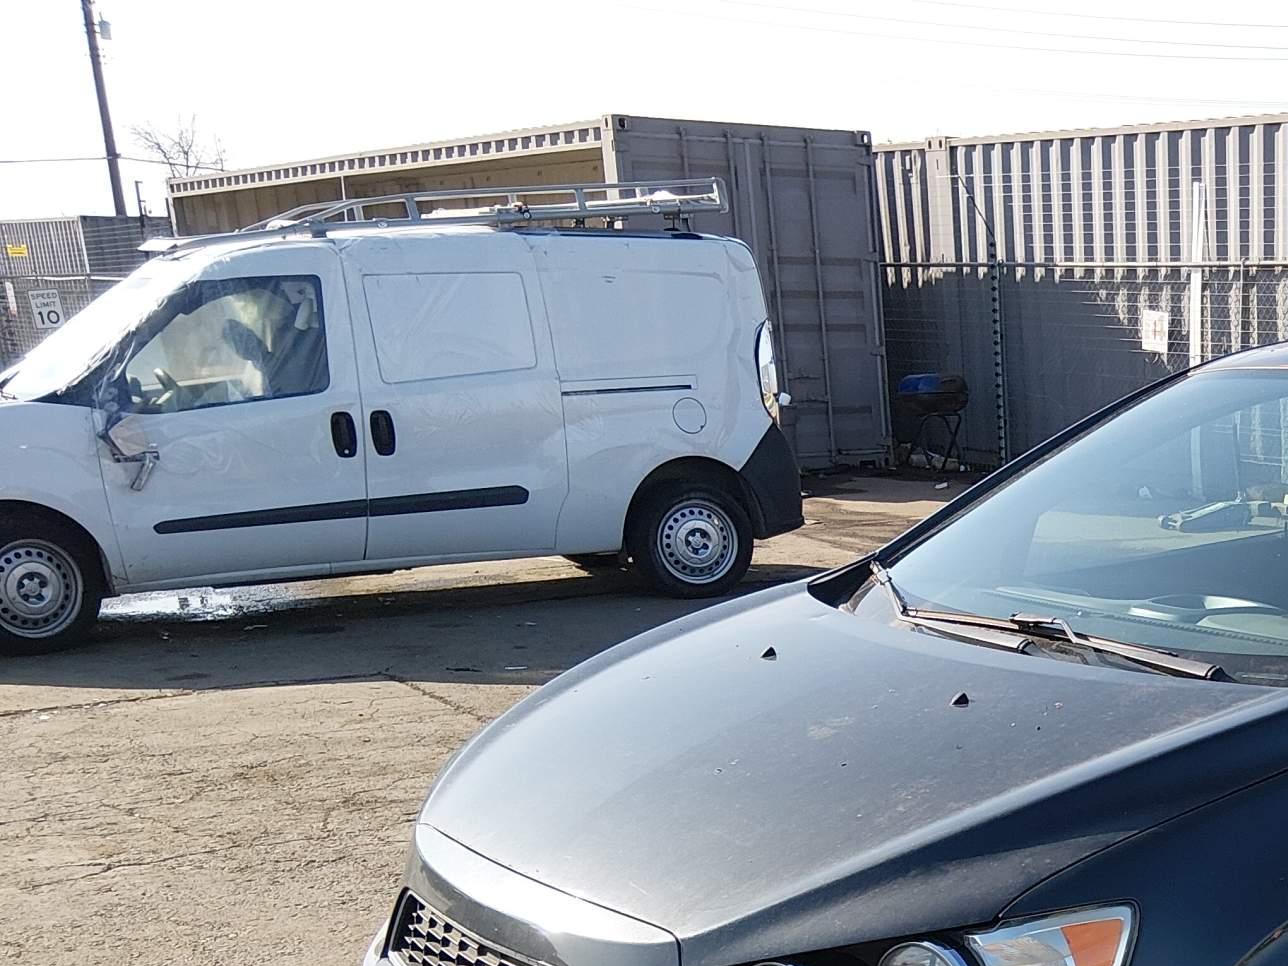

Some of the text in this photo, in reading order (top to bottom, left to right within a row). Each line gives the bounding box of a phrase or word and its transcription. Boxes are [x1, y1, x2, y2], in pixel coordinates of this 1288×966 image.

[30, 292, 58, 300] SPEED
[35, 301, 56, 309] LIMIT
[37, 310, 60, 325] 10
